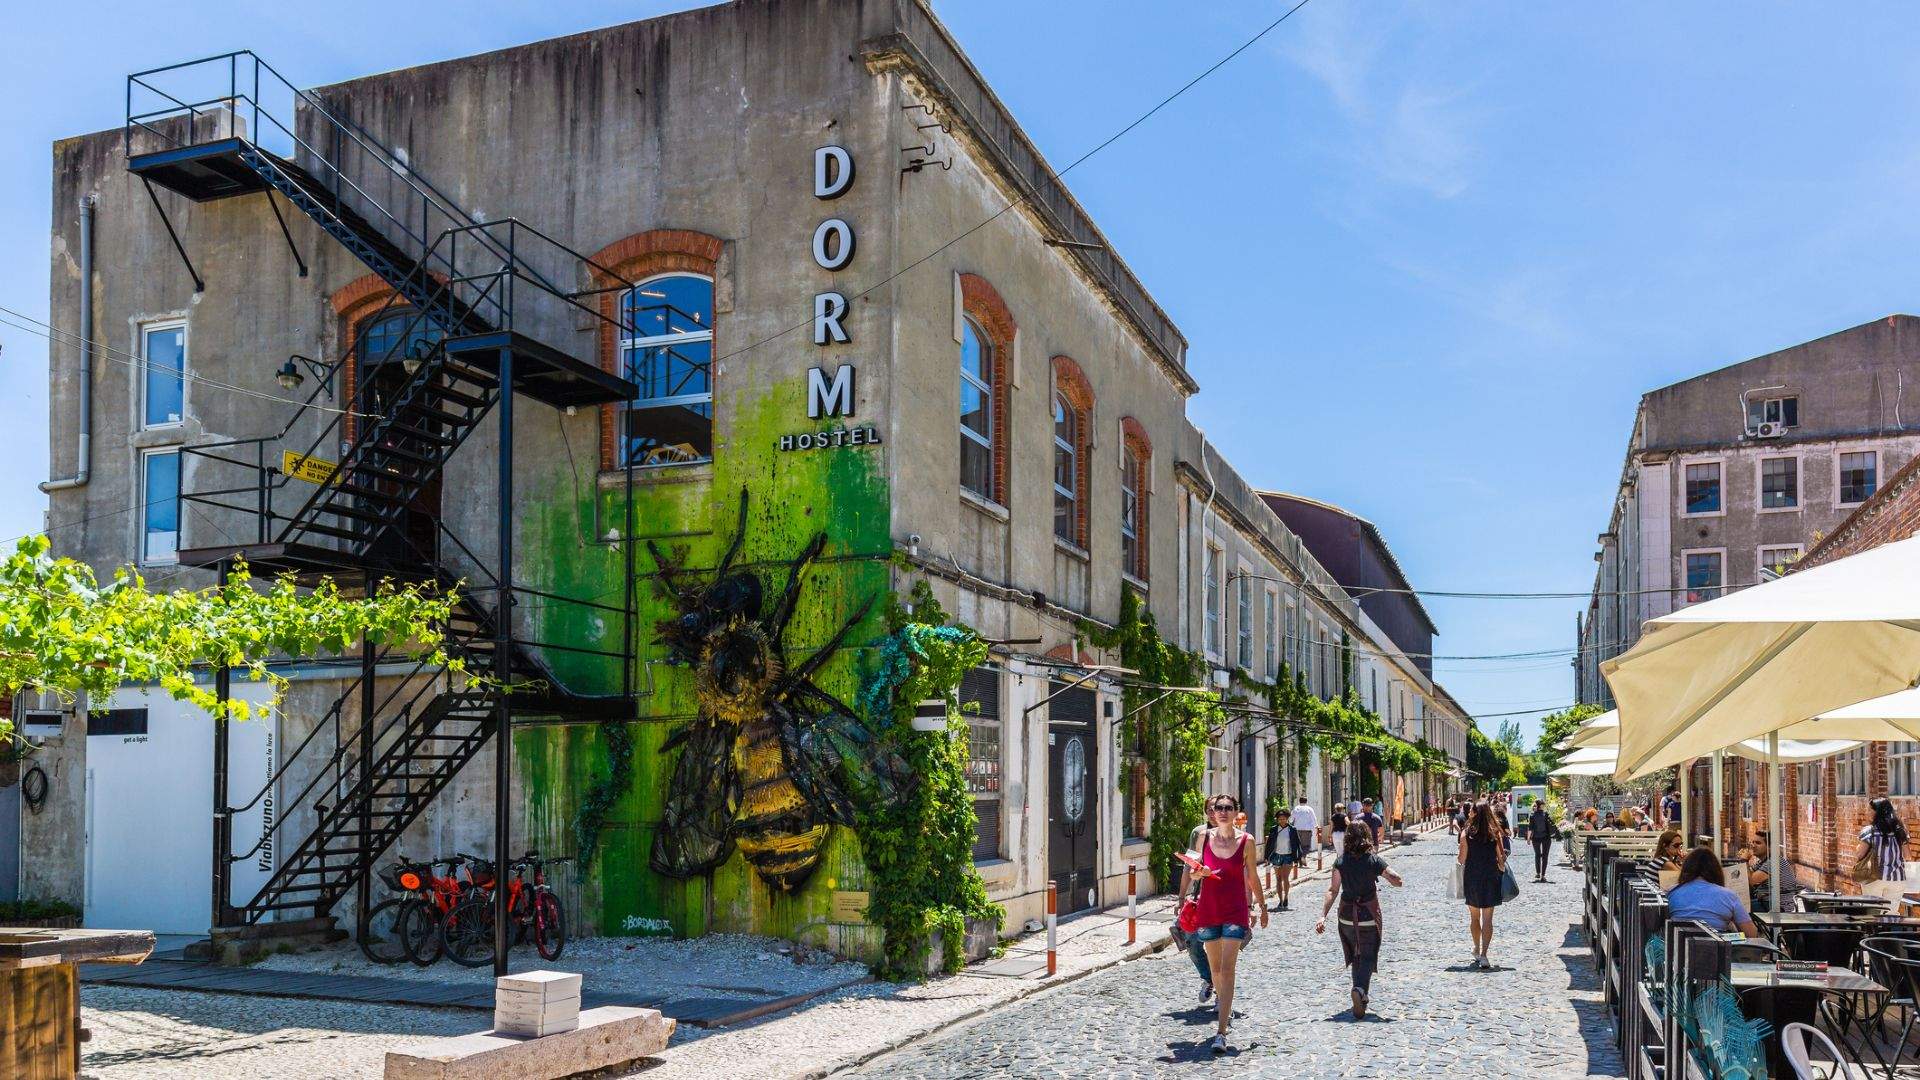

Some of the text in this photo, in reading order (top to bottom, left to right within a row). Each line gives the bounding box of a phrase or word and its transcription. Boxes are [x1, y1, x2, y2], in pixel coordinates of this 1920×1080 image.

[807, 145, 856, 420] DORM
[780, 428, 880, 451] HOSTEL
[136, 736, 148, 744] light
